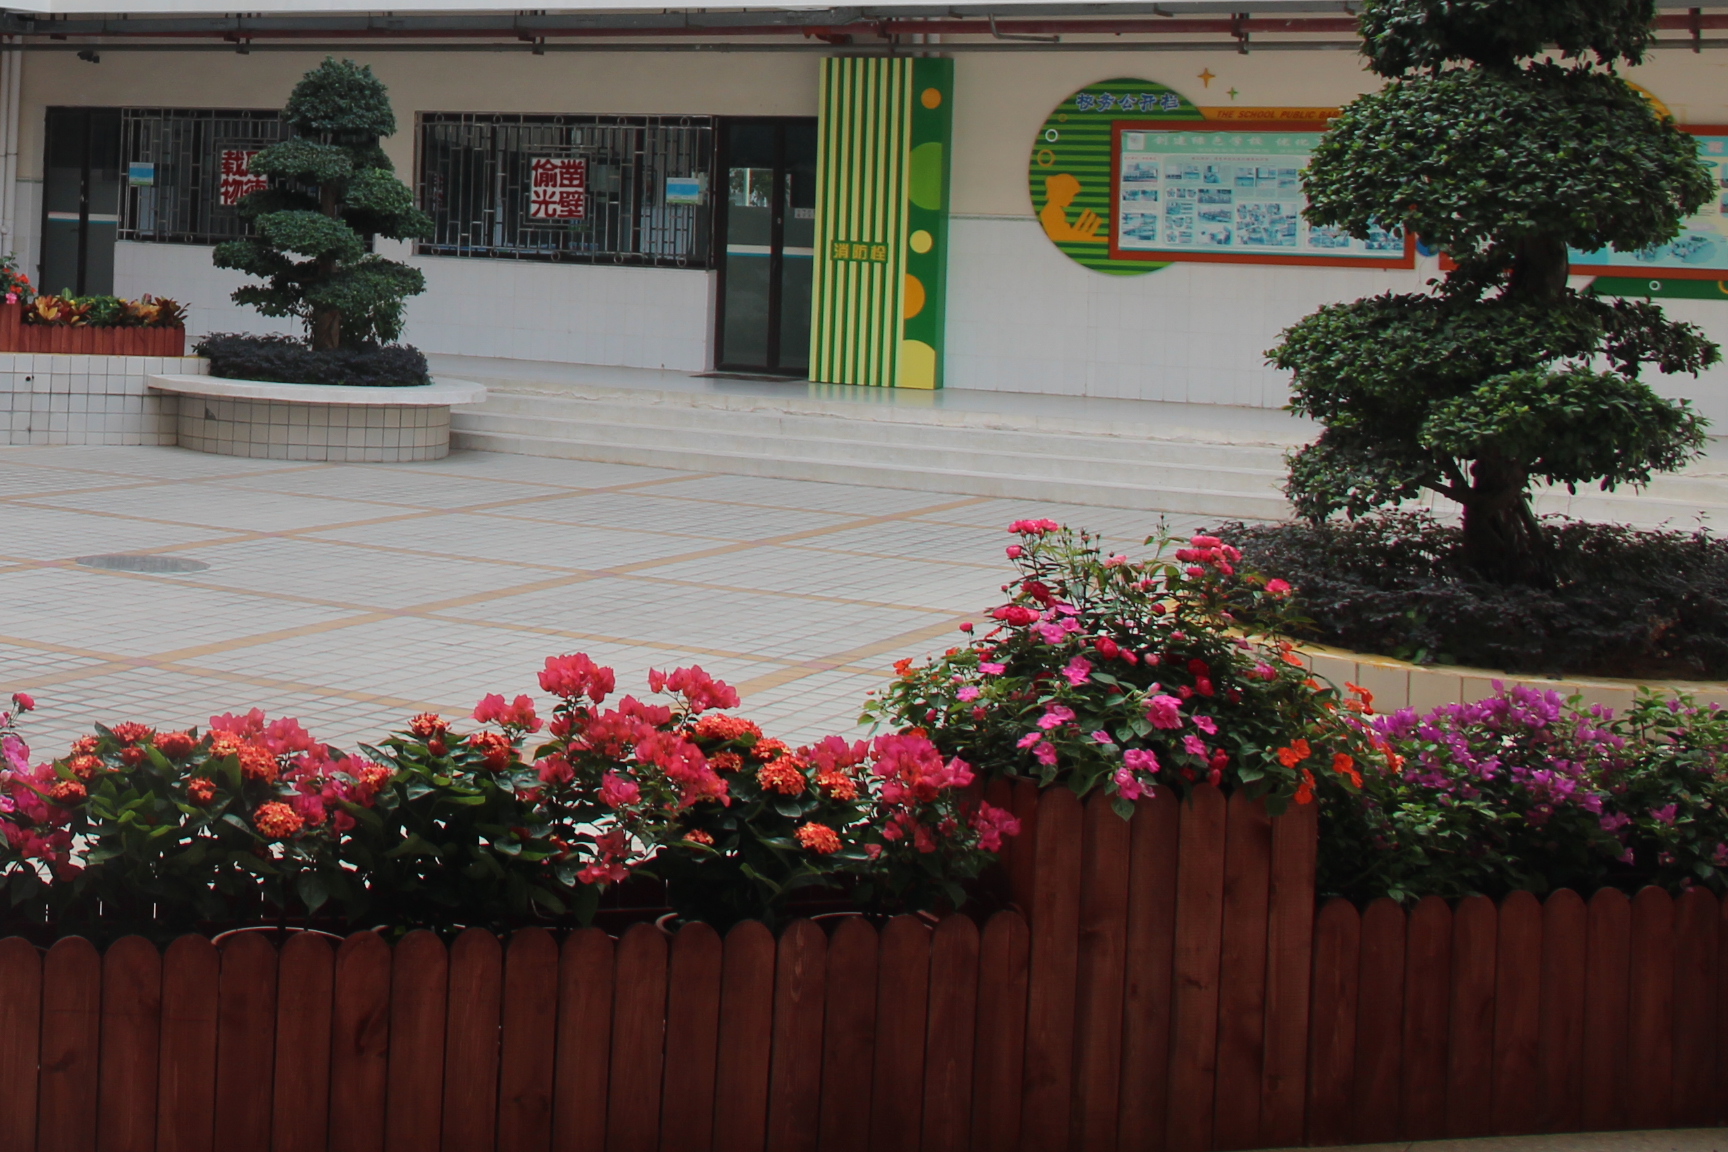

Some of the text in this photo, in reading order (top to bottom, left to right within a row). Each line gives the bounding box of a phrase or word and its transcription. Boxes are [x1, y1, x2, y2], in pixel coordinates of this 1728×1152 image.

[1076, 92, 1180, 112] 校务公开栏
[1217, 110, 1235, 119] THE
[1238, 110, 1275, 119] SCHOOL
[1279, 110, 1316, 119] PUBLIC
[833, 242, 887, 261] 消防栓
